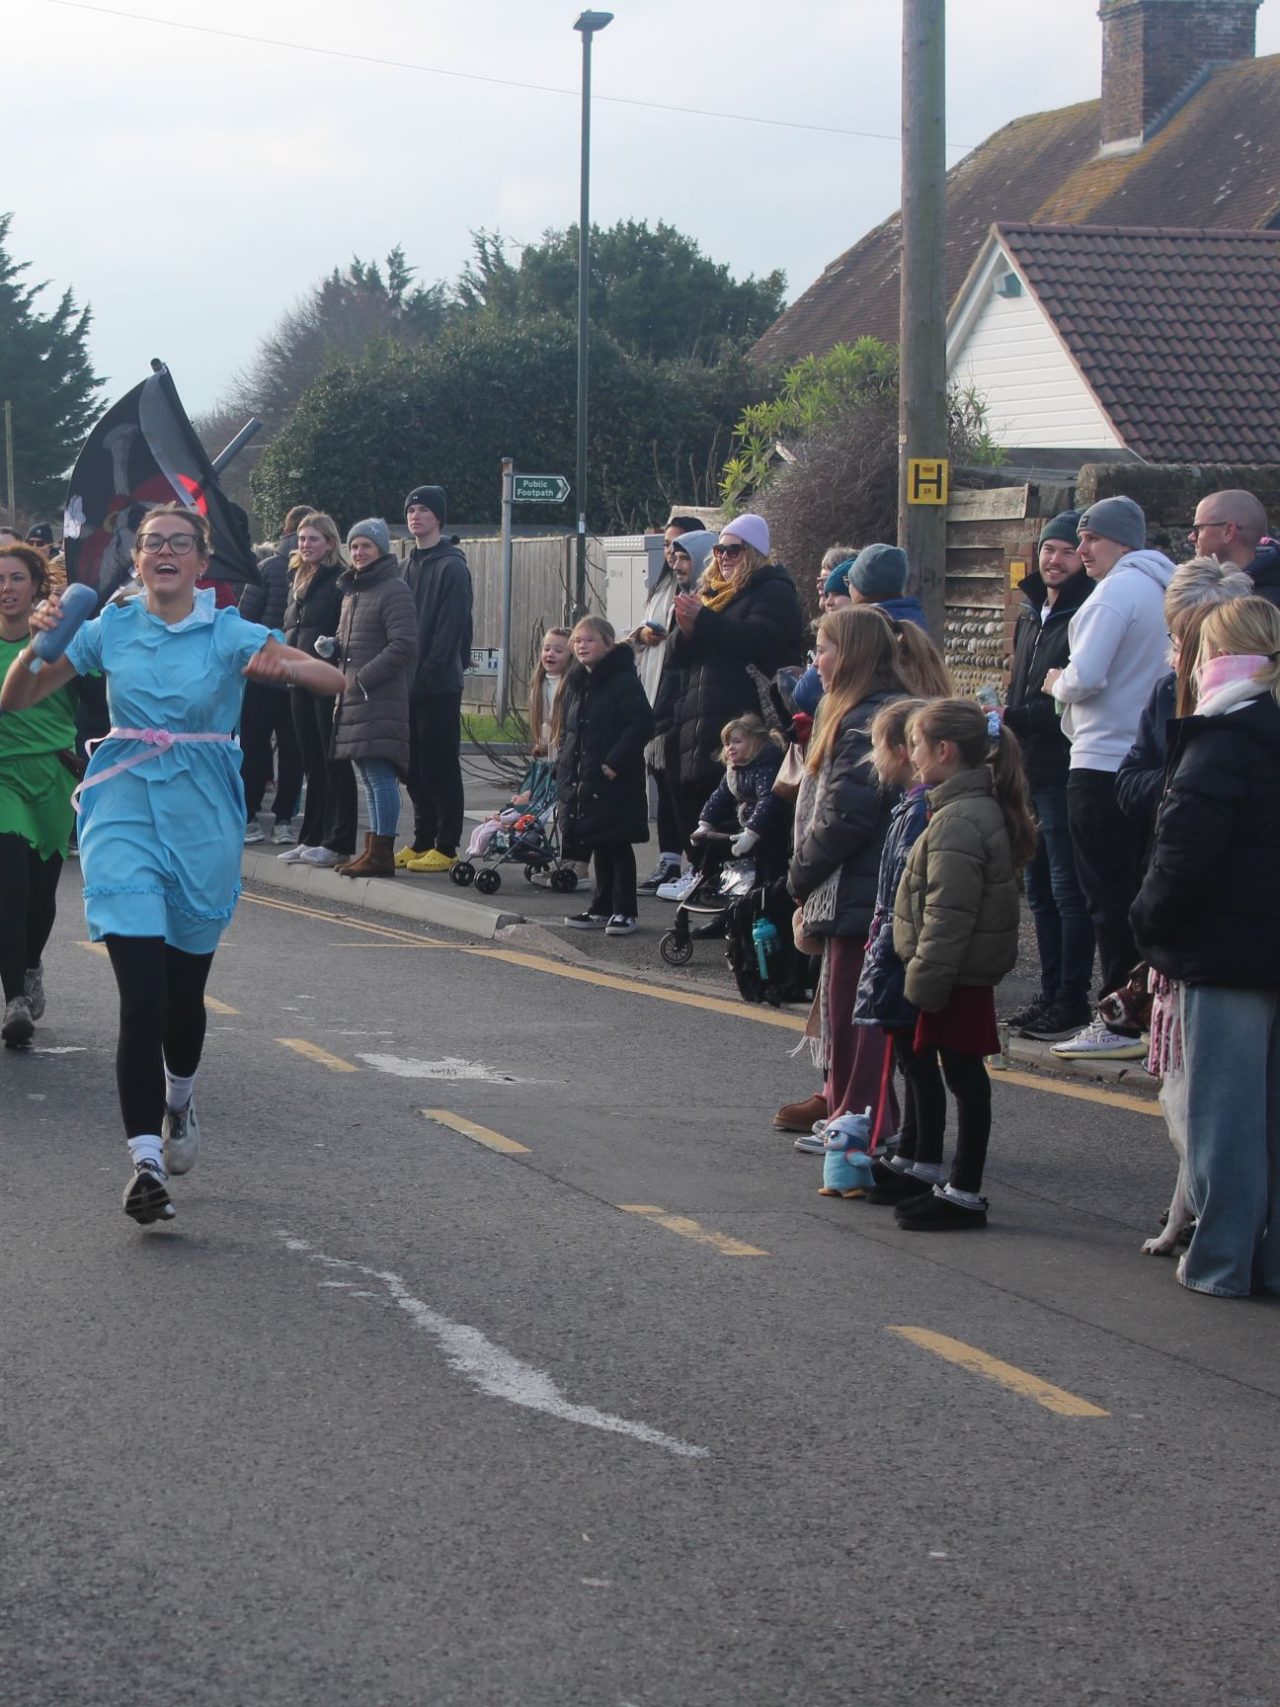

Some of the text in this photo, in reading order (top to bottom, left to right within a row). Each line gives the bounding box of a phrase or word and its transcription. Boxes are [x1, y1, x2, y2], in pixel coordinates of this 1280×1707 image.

[523, 480, 548, 488] Public
[914, 464, 942, 499] H
[517, 489, 554, 497] Footpath
